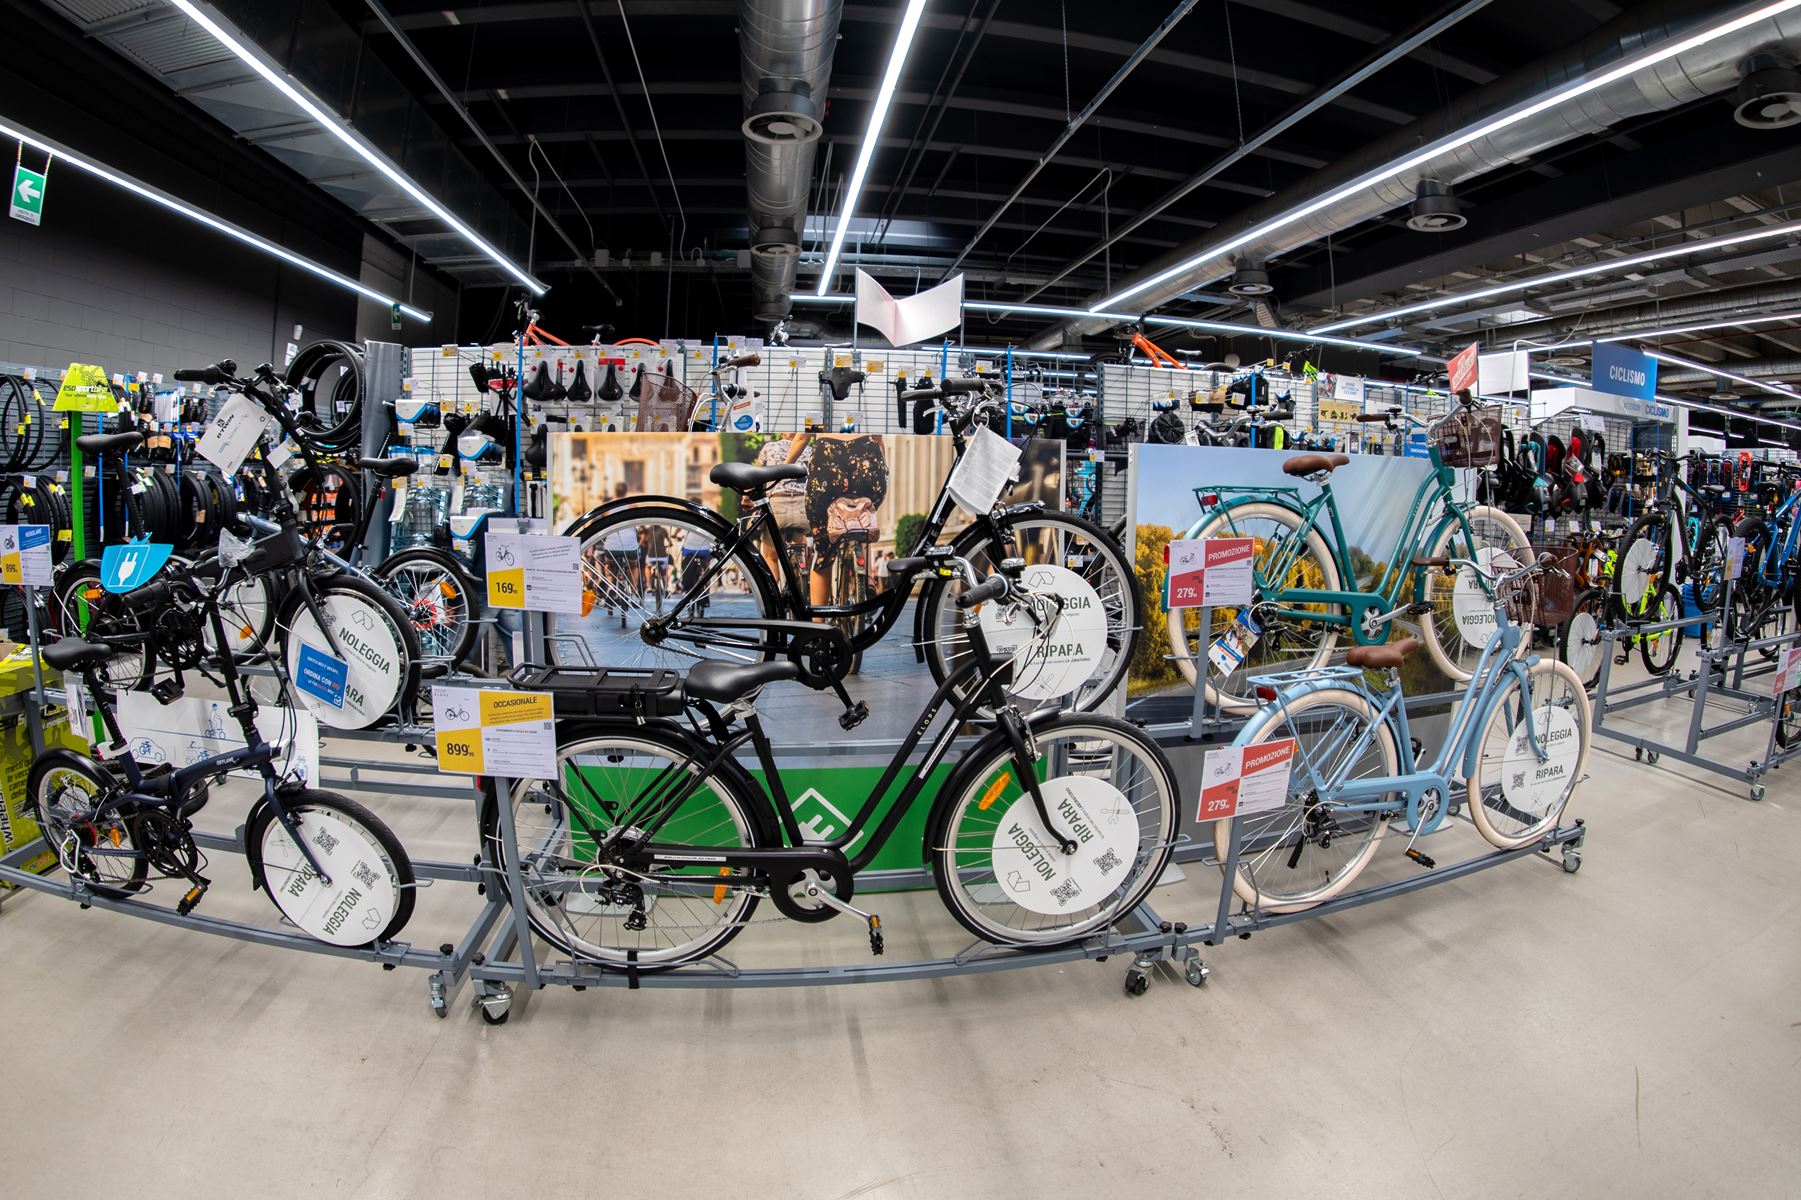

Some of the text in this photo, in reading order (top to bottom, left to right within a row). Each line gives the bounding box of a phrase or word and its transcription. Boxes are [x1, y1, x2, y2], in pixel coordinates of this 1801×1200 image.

[1609, 365, 1646, 386] CICLISMO
[1645, 404, 1670, 418] CICLISMO
[1208, 544, 1251, 562] PROMOZIONE
[496, 582, 513, 594] 169
[1177, 587, 1194, 598] 279
[1036, 596, 1091, 612] OGGIA
[339, 627, 391, 674] NOLEGGIA
[1036, 643, 1084, 658] RIPARA
[345, 684, 364, 707] ARA
[493, 696, 538, 709] OCCASIONALE
[916, 708, 937, 736] ELOPS
[1535, 728, 1572, 745] NOLEGGIA
[446, 742, 469, 756] 899
[1245, 745, 1291, 770] PROMOZIONE
[1535, 765, 1564, 780] RIPARA
[1207, 799, 1226, 812] 279
[1057, 798, 1094, 844] RIPARA
[1008, 822, 1056, 882] NOLEGGIA
[323, 887, 363, 936] NOLEGGIA
